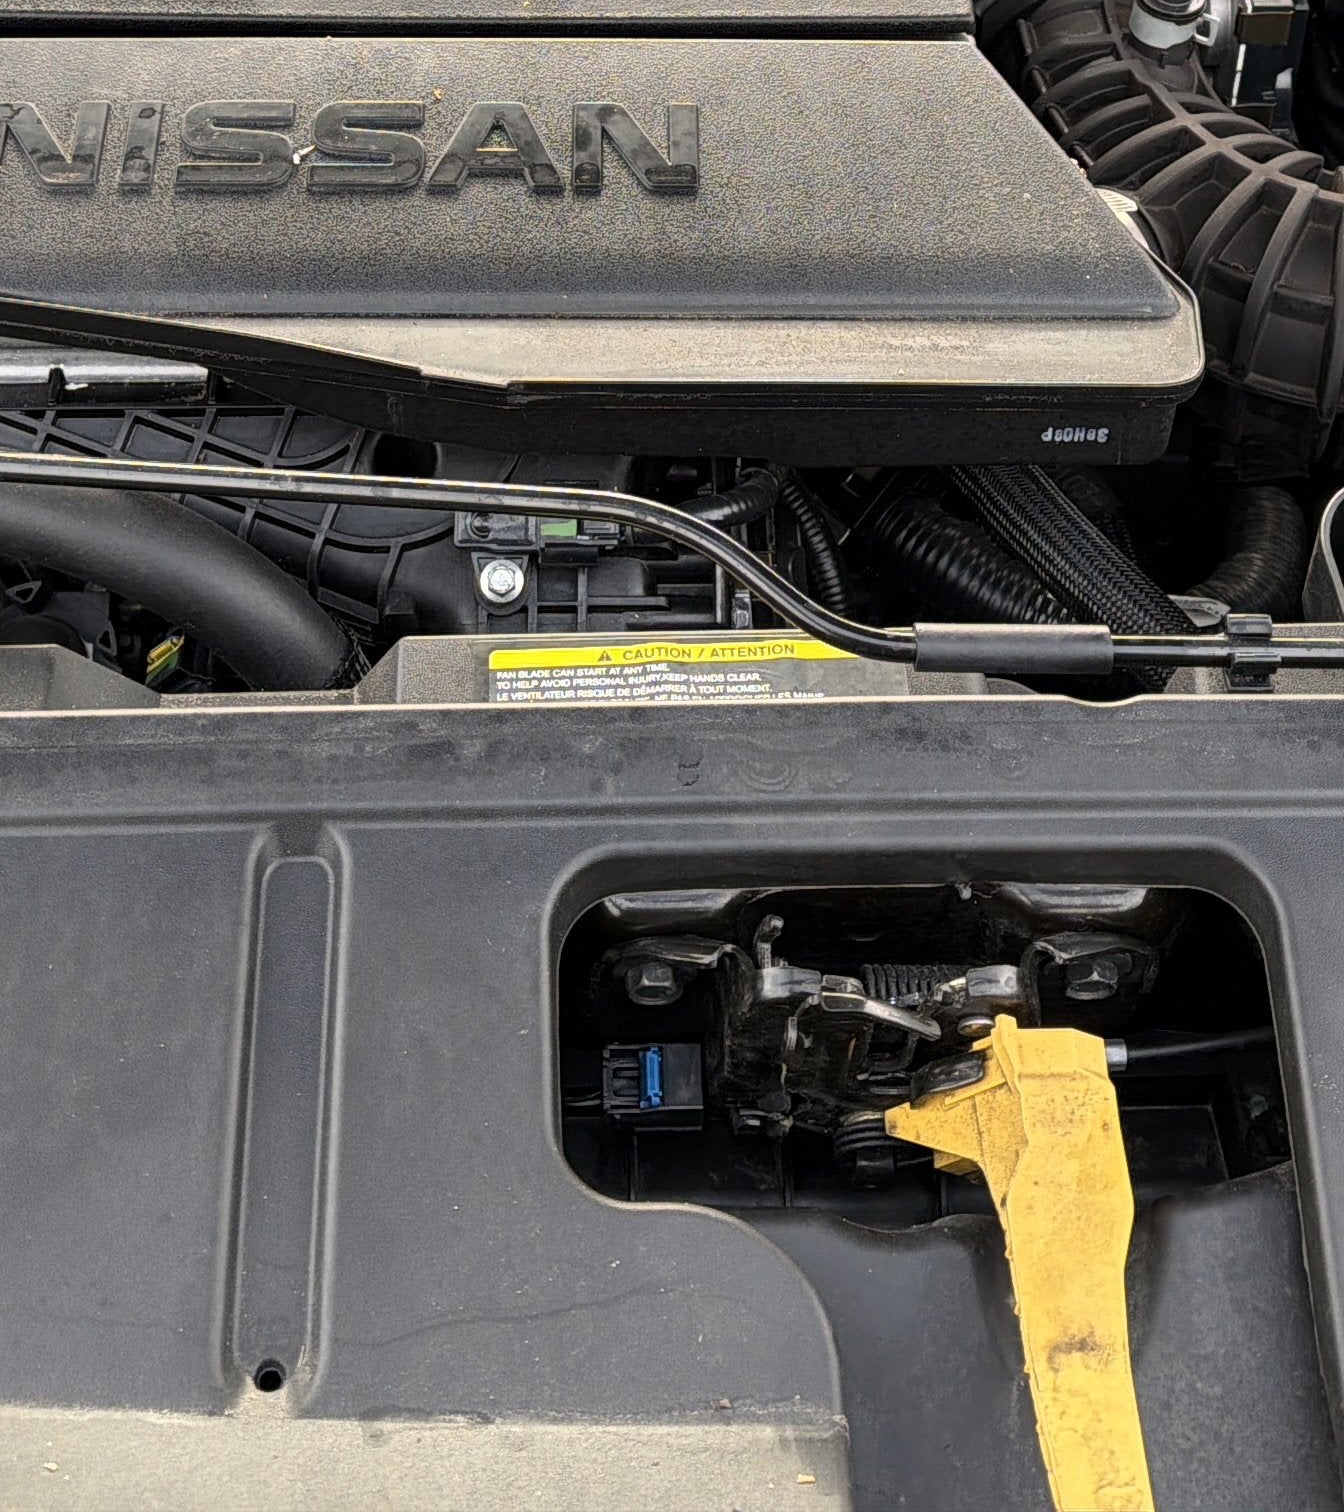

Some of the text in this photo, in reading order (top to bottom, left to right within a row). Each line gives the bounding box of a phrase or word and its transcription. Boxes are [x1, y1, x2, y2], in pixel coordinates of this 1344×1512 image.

[623, 647, 692, 661] CAUTION
[710, 644, 795, 658] ATTENTION
[496, 671, 516, 680] FAN
[518, 670, 550, 678] BLADE
[552, 668, 574, 678] CAN
[576, 668, 607, 676] START
[609, 667, 621, 676] AT
[623, 665, 644, 675] ANY
[496, 682, 510, 690] TO
[513, 680, 538, 689] HELP
[540, 678, 570, 688] AVOID
[572, 676, 626, 687] PERSONAL
[690, 673, 725, 682] HANDS
[496, 692, 509, 702] LE
[510, 690, 576, 701] VENTILATEUR
[577, 688, 615, 698] RISQUE
[617, 688, 631, 696] DE
[698, 685, 725, 694] TOUT
[726, 684, 773, 693] MOMENT.
